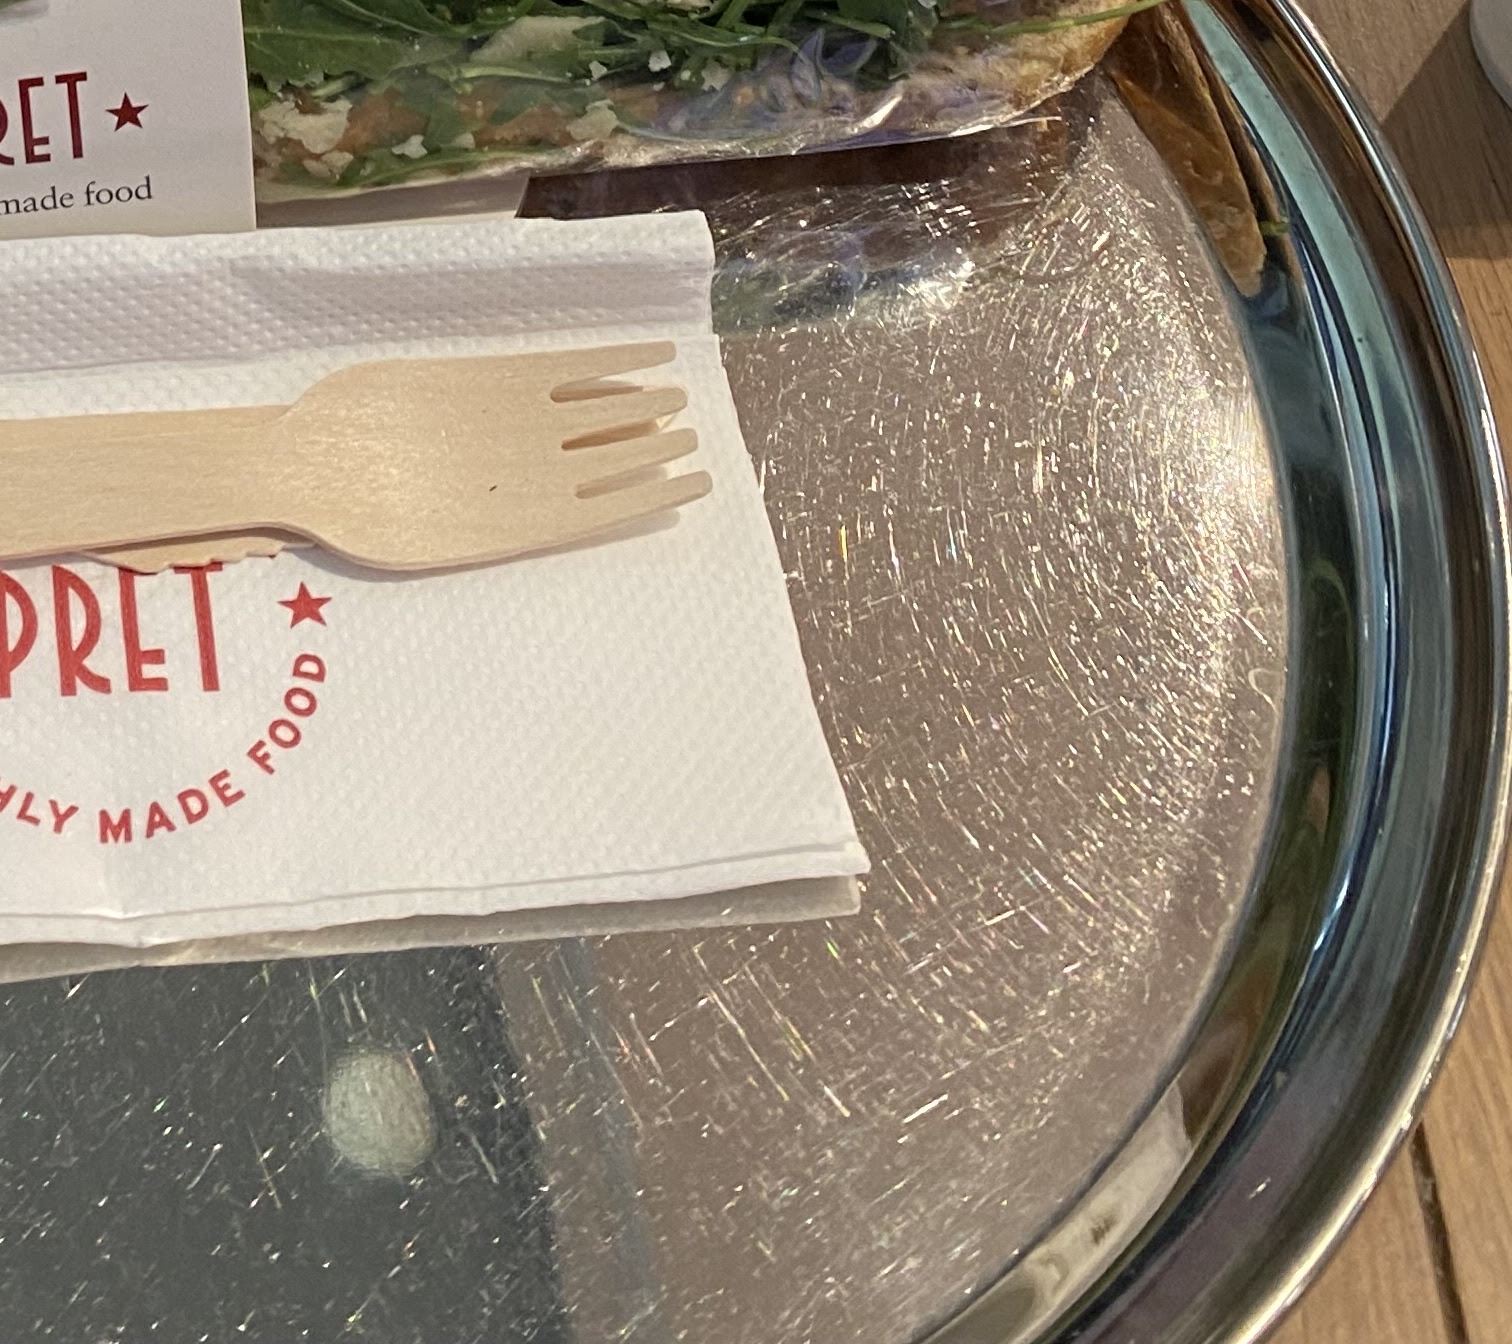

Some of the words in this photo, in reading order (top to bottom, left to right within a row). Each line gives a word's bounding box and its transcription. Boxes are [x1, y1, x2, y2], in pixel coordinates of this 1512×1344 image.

[83, 175, 154, 207] food
[98, 768, 247, 845] MADE
[246, 652, 327, 775] FOOD
